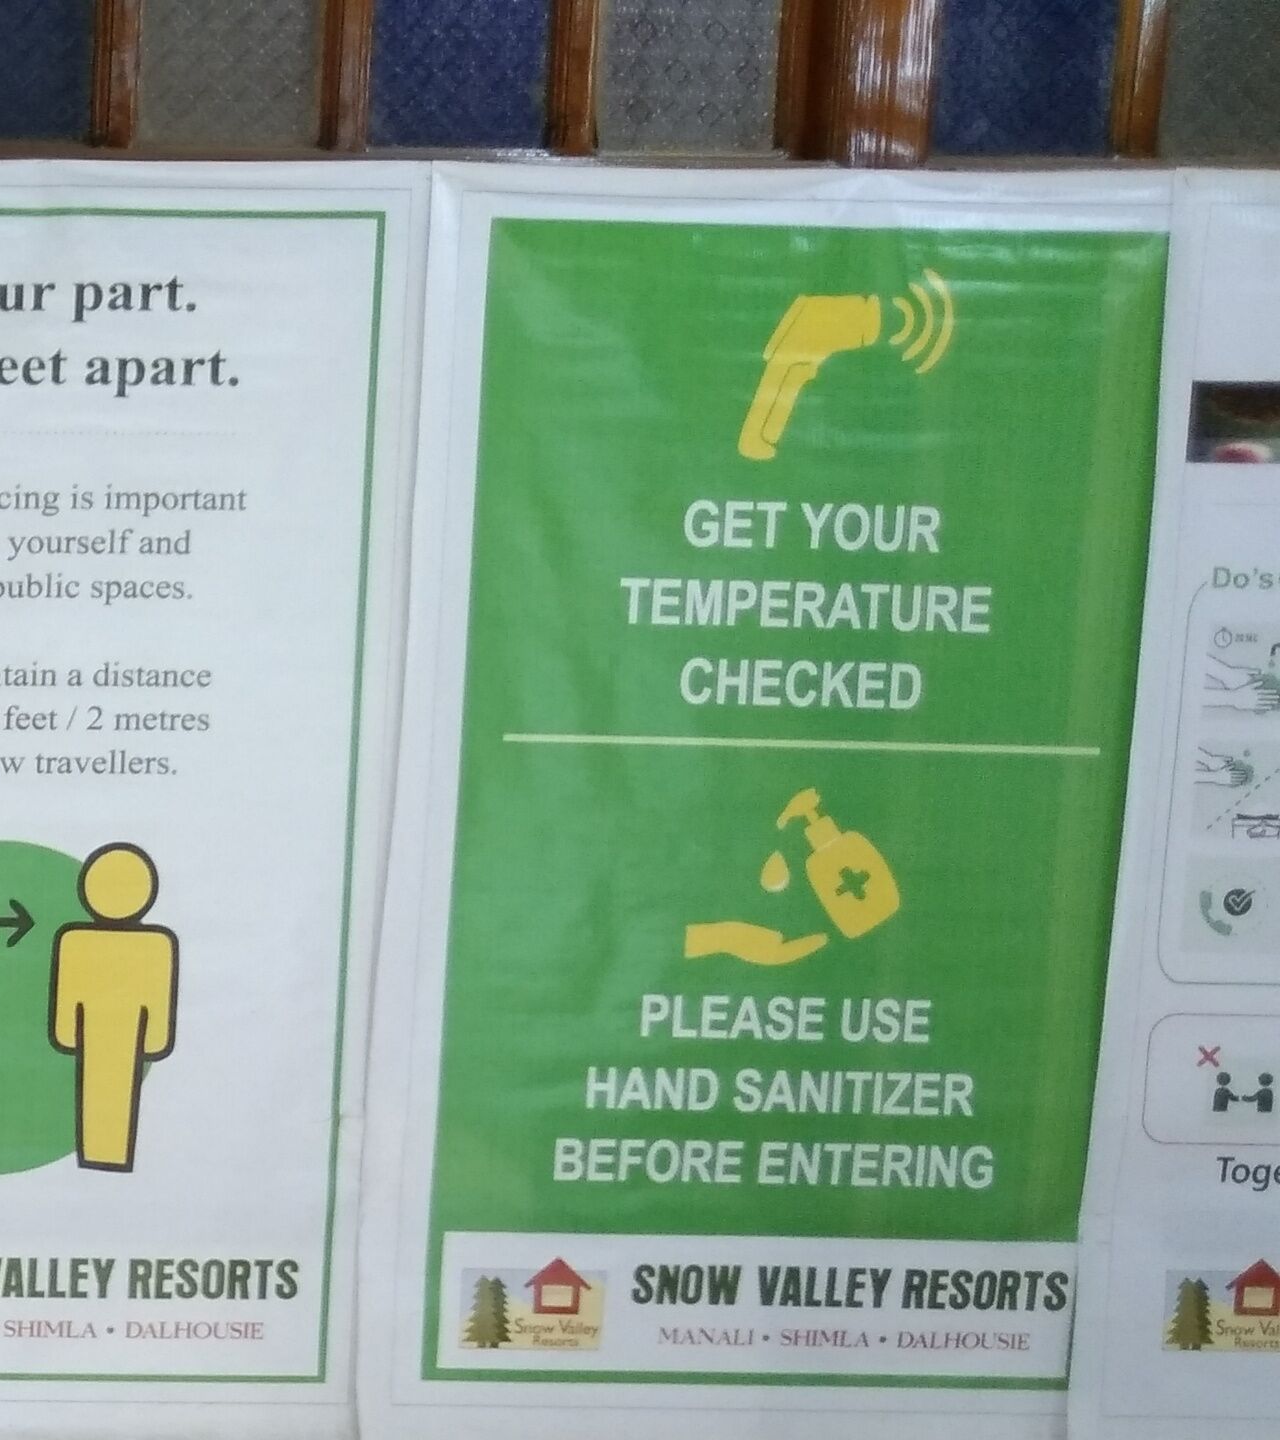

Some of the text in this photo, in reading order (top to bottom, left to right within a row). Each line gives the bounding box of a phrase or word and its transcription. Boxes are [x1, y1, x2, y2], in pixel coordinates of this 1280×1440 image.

[72, 275, 197, 322] part.
[85, 348, 240, 397] apart.
[71, 484, 93, 511] is
[105, 485, 248, 517] important
[683, 499, 941, 554] GET YOUR
[7, 528, 133, 564] yourself
[138, 529, 192, 556] and
[90, 581, 193, 606] spaces.
[1213, 566, 1274, 590] Do's
[620, 576, 992, 634] TEMPERATURE
[67, 669, 83, 688] a
[92, 662, 212, 689] distance
[679, 657, 923, 711] CHECKED
[2, 704, 58, 731] feet
[66, 704, 77, 731] /
[85, 705, 104, 731] 2
[114, 710, 211, 732] metres
[35, 748, 179, 776] travellers.
[640, 994, 933, 1044] PLEASE USE
[585, 1066, 974, 1118] HAND SANITIZER
[553, 1138, 995, 1190] BEFORE ENTERING
[128, 1258, 300, 1300] RESORTS
[631, 1264, 1069, 1311] SNOW VALLEY RESORTS
[3, 1319, 98, 1339] SHIMLA
[125, 1320, 265, 1340] DALHOUSIE
[514, 1318, 599, 1338] Snow Valley
[533, 1335, 579, 1347] Resorts
[658, 1327, 1031, 1350] MANALI SHIMLA DALHOUSIE
